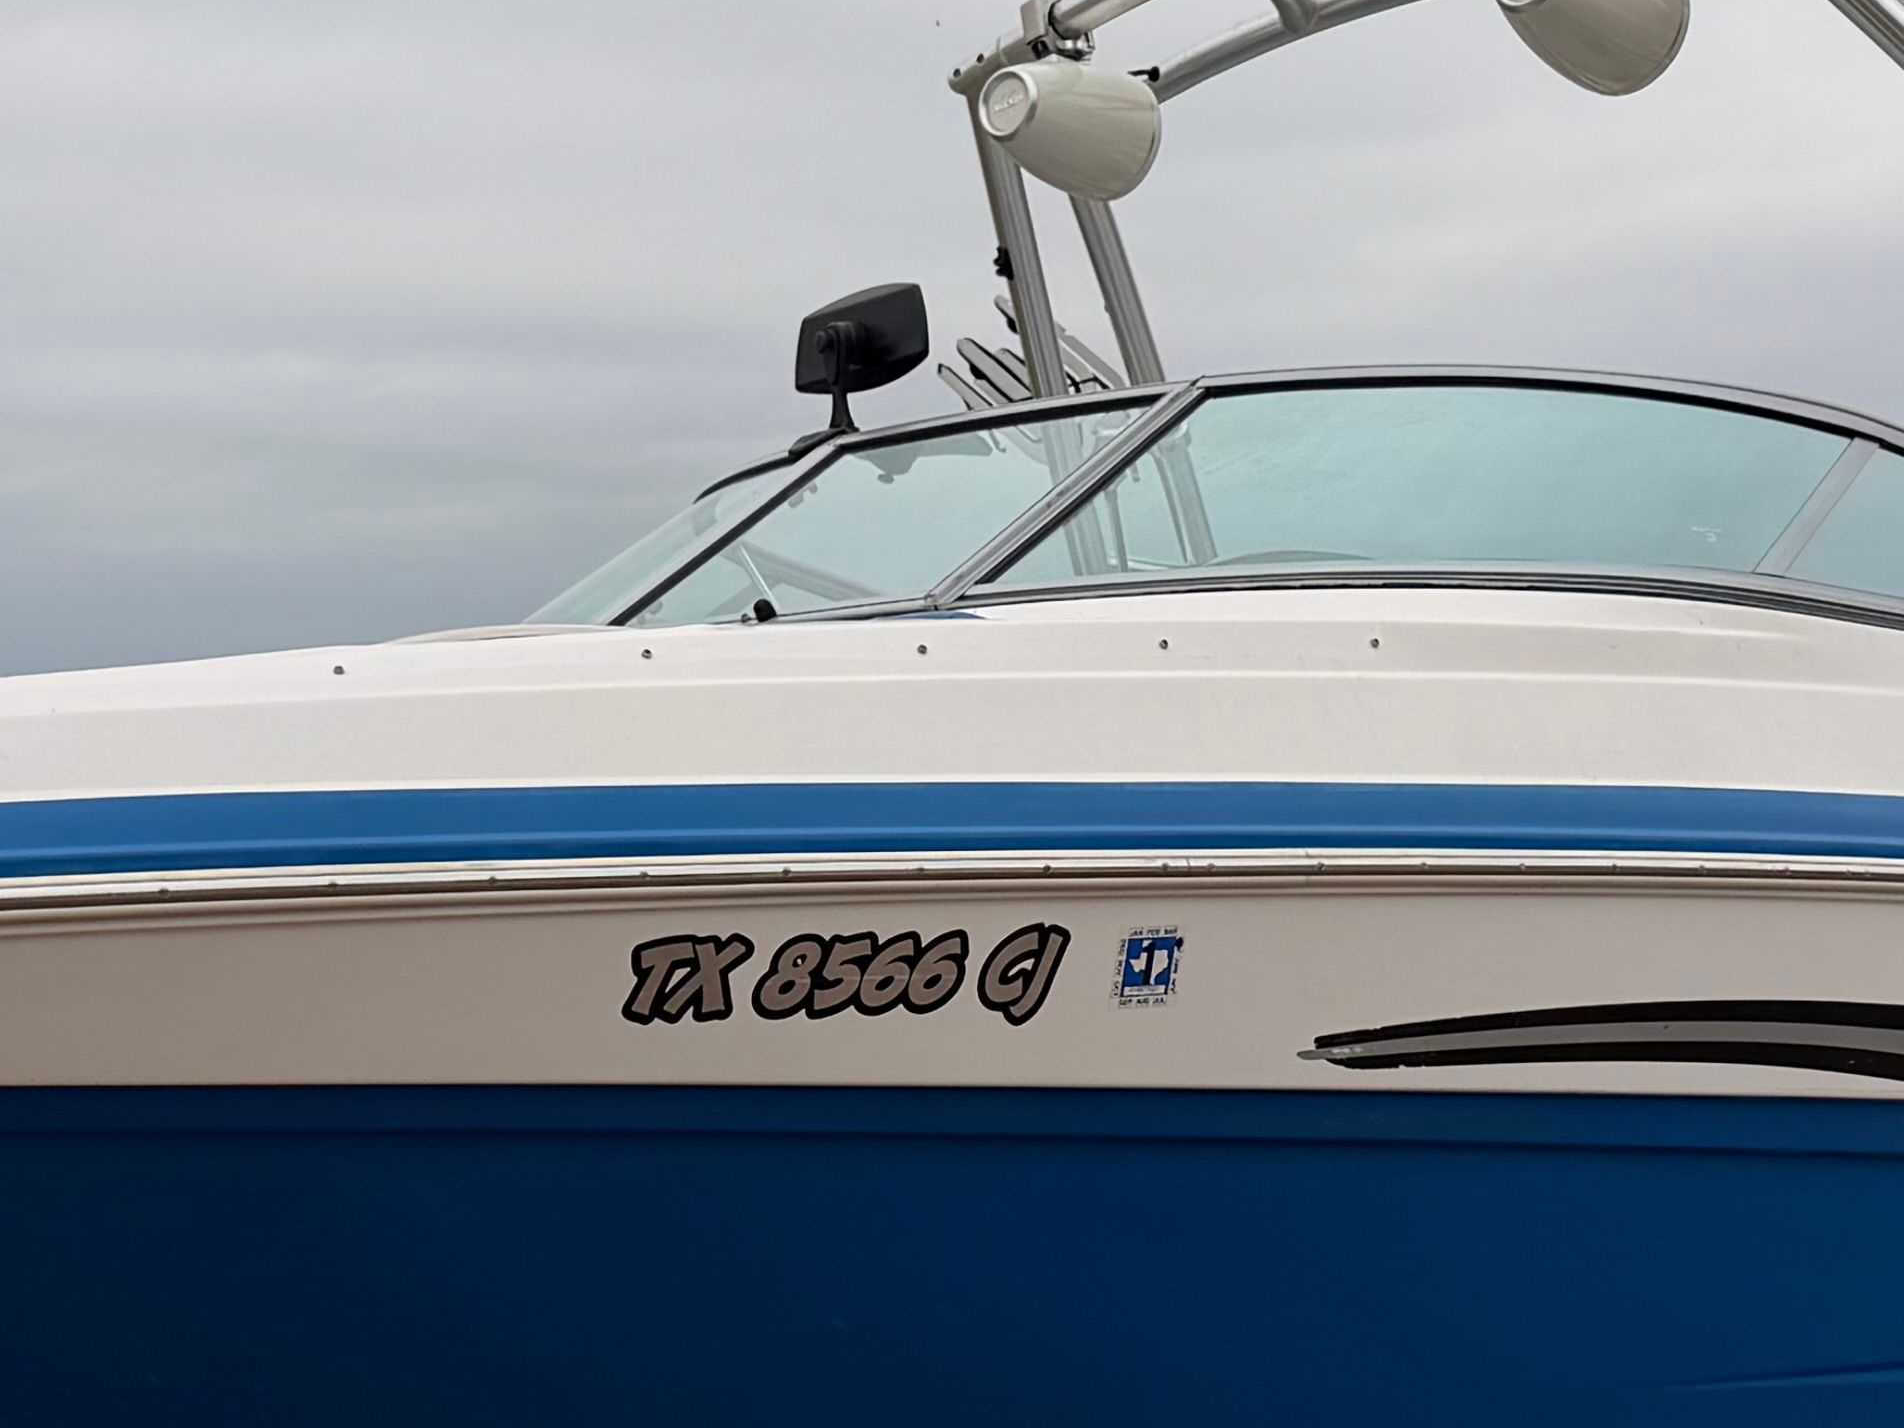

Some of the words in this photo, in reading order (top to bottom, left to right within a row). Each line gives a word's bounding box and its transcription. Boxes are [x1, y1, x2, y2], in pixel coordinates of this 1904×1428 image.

[621, 932, 755, 1025] TX
[751, 928, 970, 1020] 8566
[977, 922, 1072, 1026] CJ
